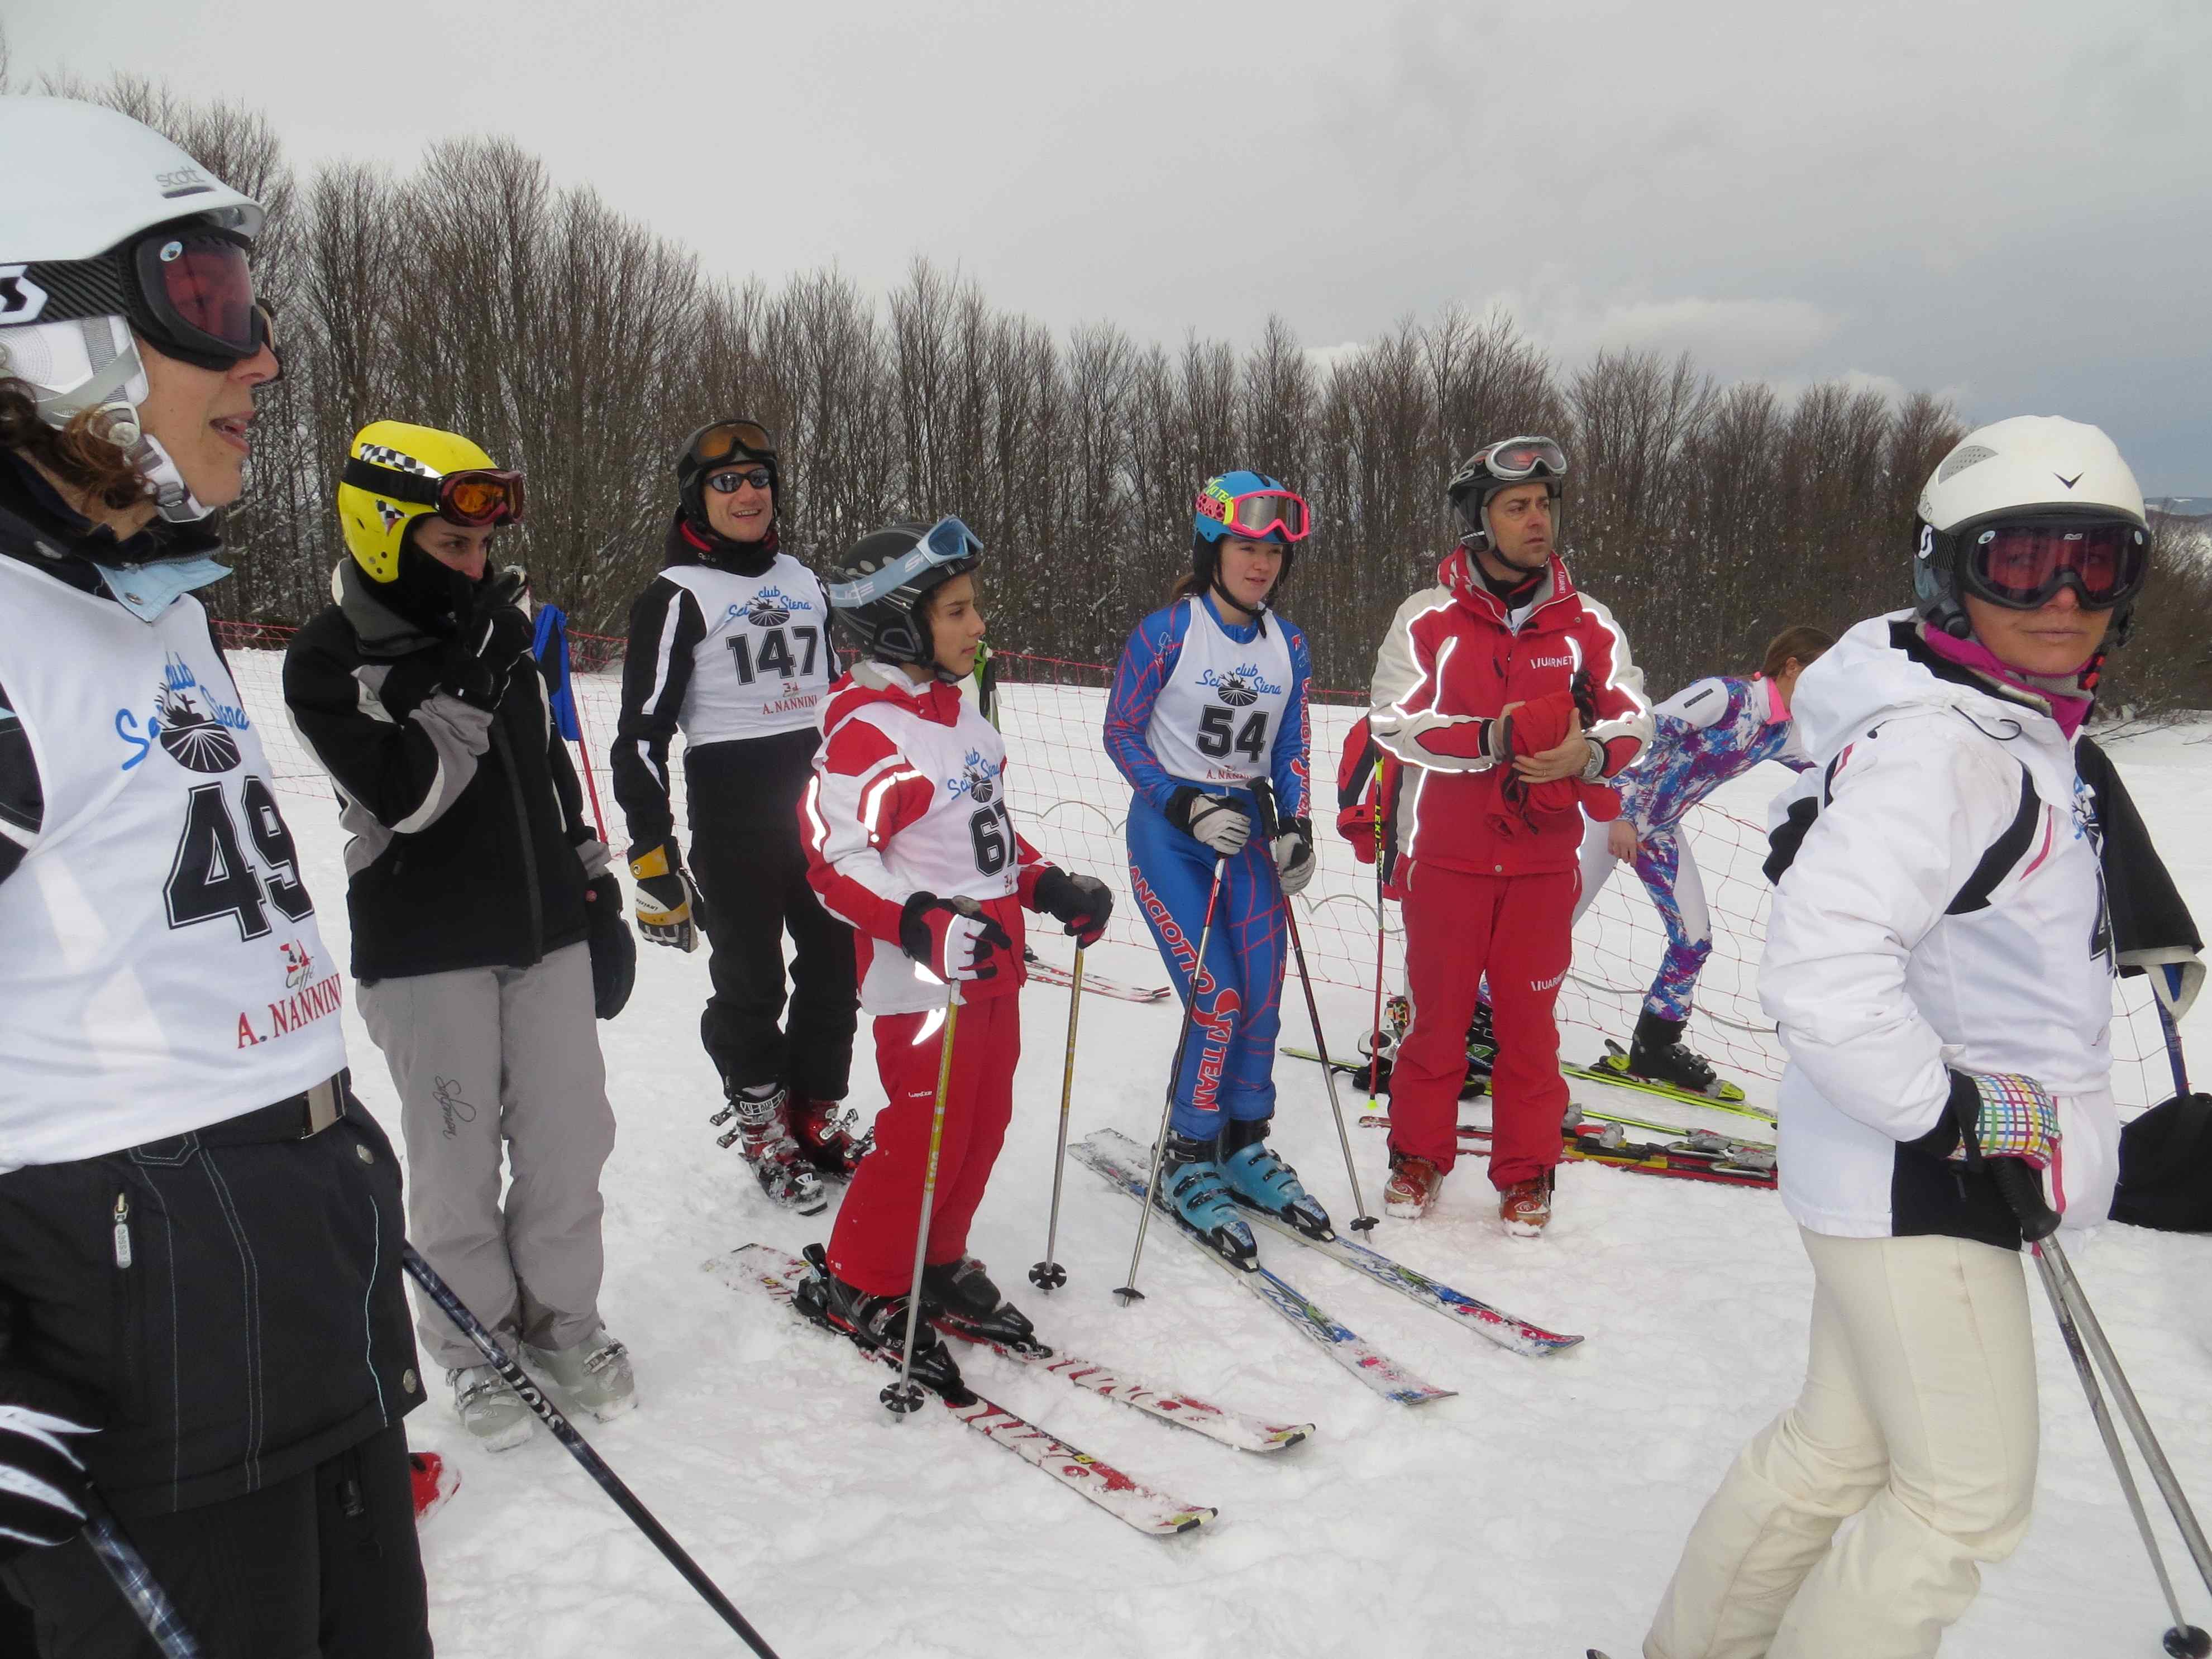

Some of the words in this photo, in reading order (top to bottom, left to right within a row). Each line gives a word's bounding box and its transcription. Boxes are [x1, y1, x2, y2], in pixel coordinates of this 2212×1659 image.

[156, 165, 206, 187] scott
[728, 604, 751, 617] Sci
[758, 585, 781, 599] club
[778, 595, 812, 611] Siena
[725, 625, 819, 686] 147
[1530, 655, 1574, 669] VUARNET
[1195, 668, 1222, 688] Sci
[1235, 662, 1259, 677] club
[1253, 676, 1282, 695] Siena
[762, 702, 774, 715] A.
[775, 694, 818, 713] NANNINI
[1195, 704, 1269, 763] 54
[947, 778, 972, 801] Sci
[162, 775, 314, 942] 49
[238, 1012, 268, 1049] A.
[1192, 1046, 1227, 1112] TEAM
